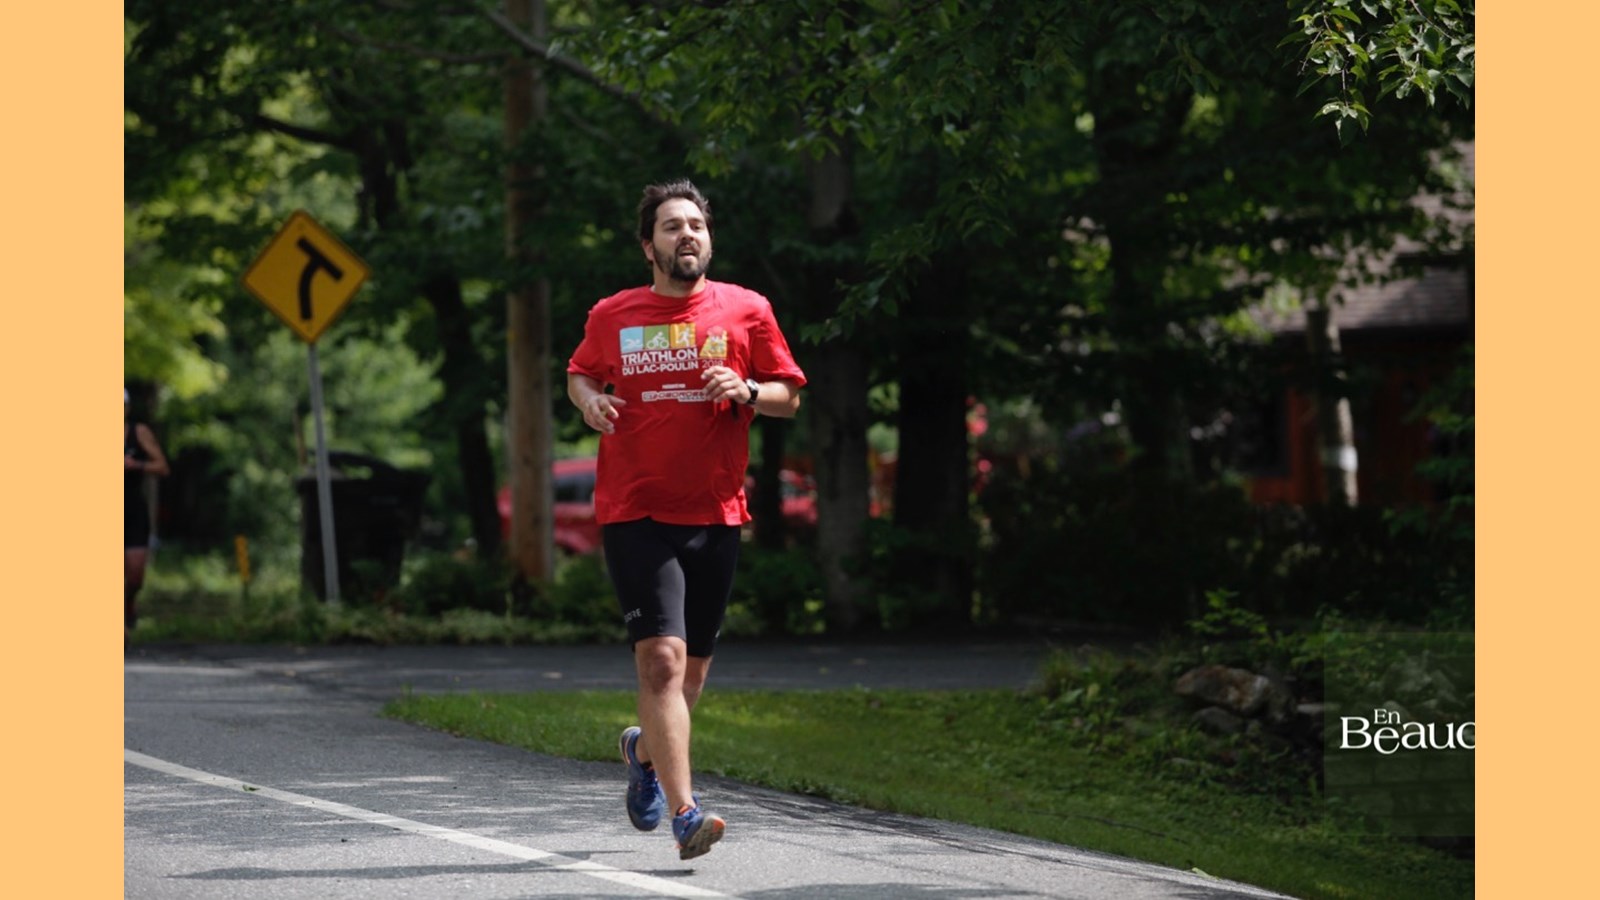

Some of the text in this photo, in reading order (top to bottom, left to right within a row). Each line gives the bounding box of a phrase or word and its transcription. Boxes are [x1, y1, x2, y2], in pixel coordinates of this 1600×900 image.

[621, 348, 697, 365] TRIATHLON
[622, 366, 634, 376] DU
[636, 361, 698, 374] LAC-POULIN
